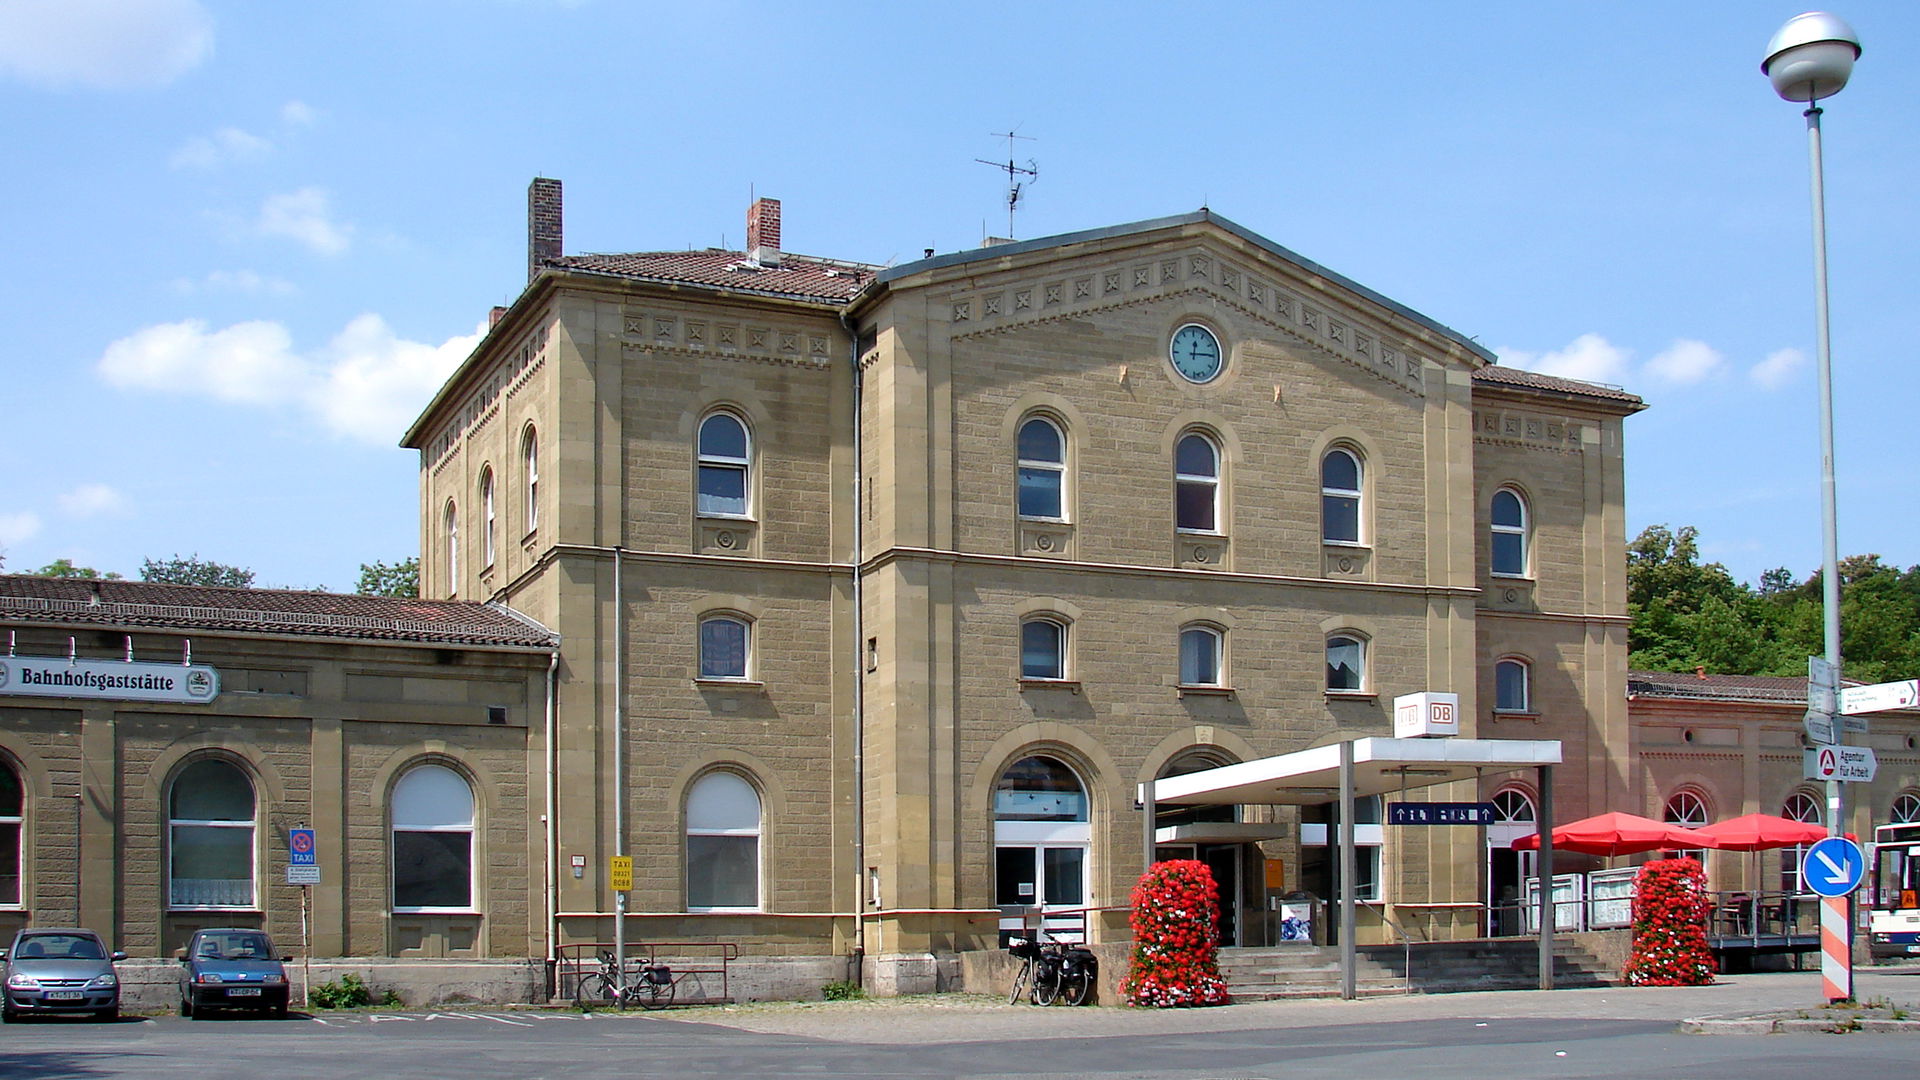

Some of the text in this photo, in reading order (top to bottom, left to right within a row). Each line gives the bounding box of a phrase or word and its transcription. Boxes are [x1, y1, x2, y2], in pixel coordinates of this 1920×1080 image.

[22, 668, 174, 691] Bahnhofsgaststätte
[1432, 705, 1451, 721] DB
[1839, 750, 1865, 764] Agentur
[1840, 765, 1869, 778] für Arbeit
[294, 854, 314, 863] TAXI
